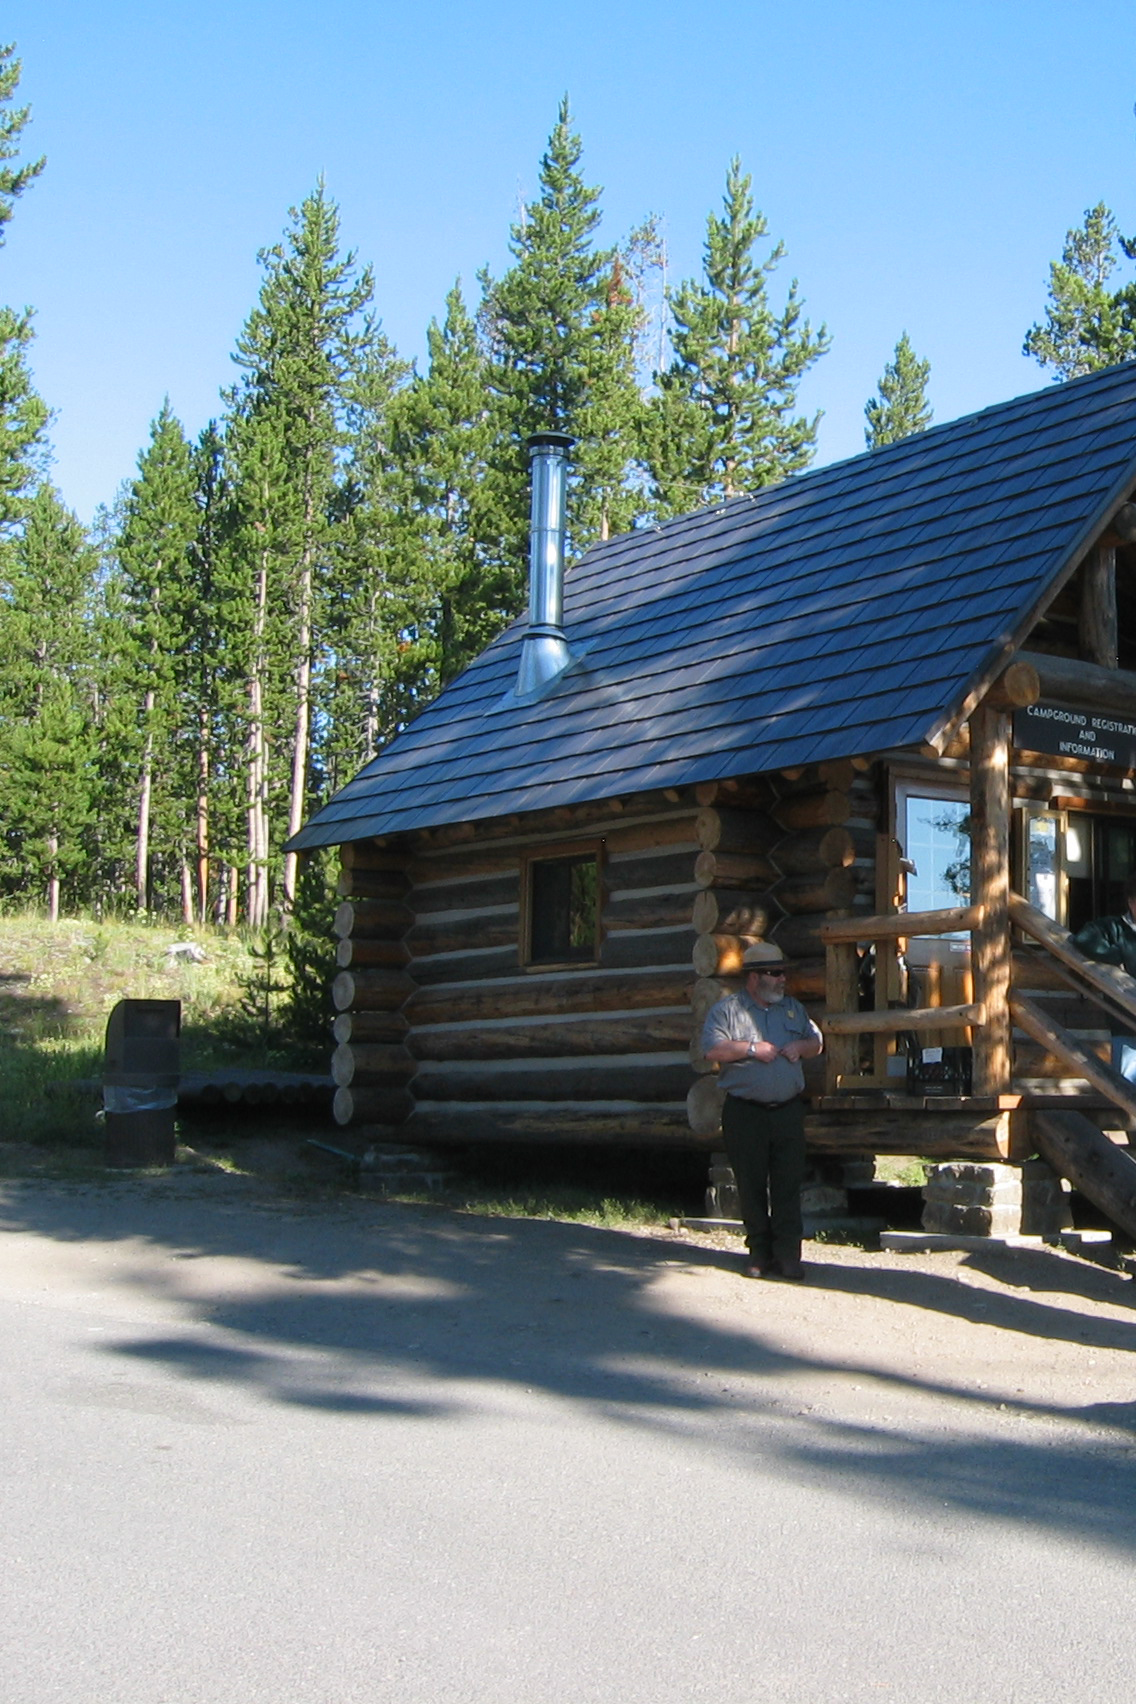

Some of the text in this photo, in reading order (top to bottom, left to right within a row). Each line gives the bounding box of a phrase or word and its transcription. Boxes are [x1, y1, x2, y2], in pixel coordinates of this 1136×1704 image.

[1027, 705, 1087, 726] CAMPGROUND
[1079, 730, 1096, 742] AND
[1059, 741, 1115, 760] INFORMATION
